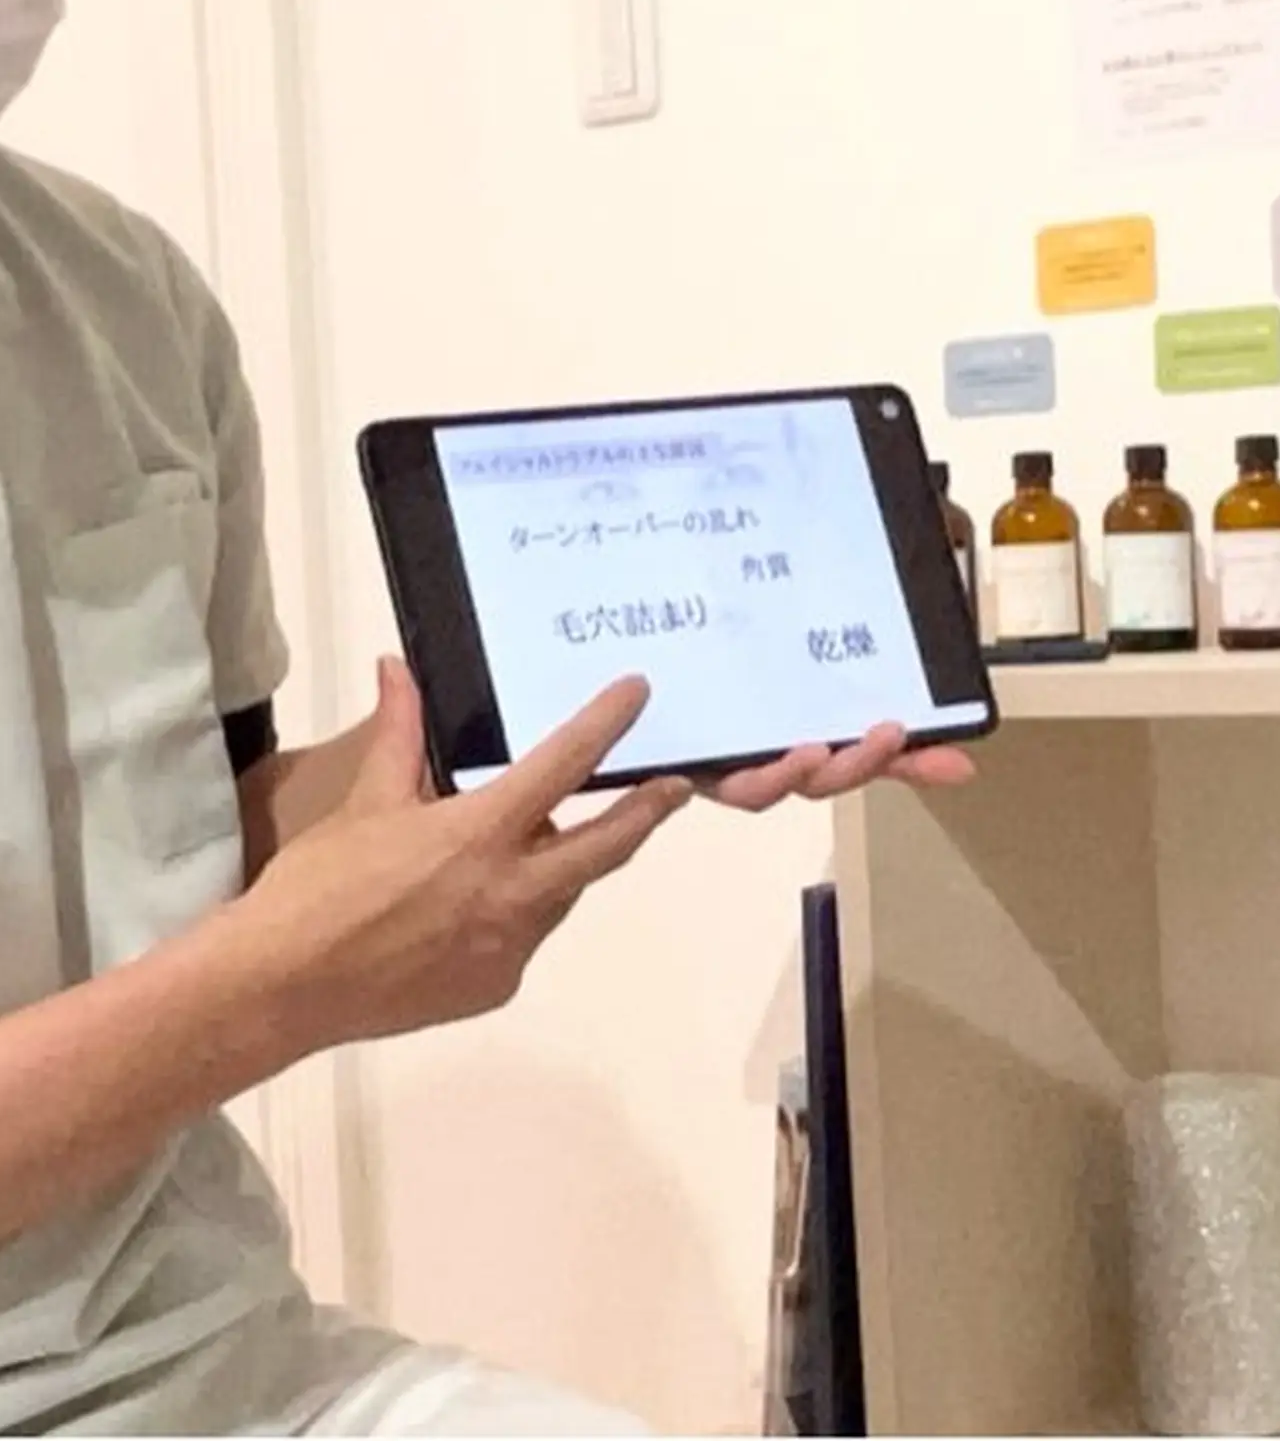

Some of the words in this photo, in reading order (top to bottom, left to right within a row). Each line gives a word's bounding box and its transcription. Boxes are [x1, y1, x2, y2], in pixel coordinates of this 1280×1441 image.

[509, 504, 761, 552] ターンオーバーの乱れ
[552, 593, 708, 644] 毛穴詰まり
[806, 621, 877, 663] 乾燥
